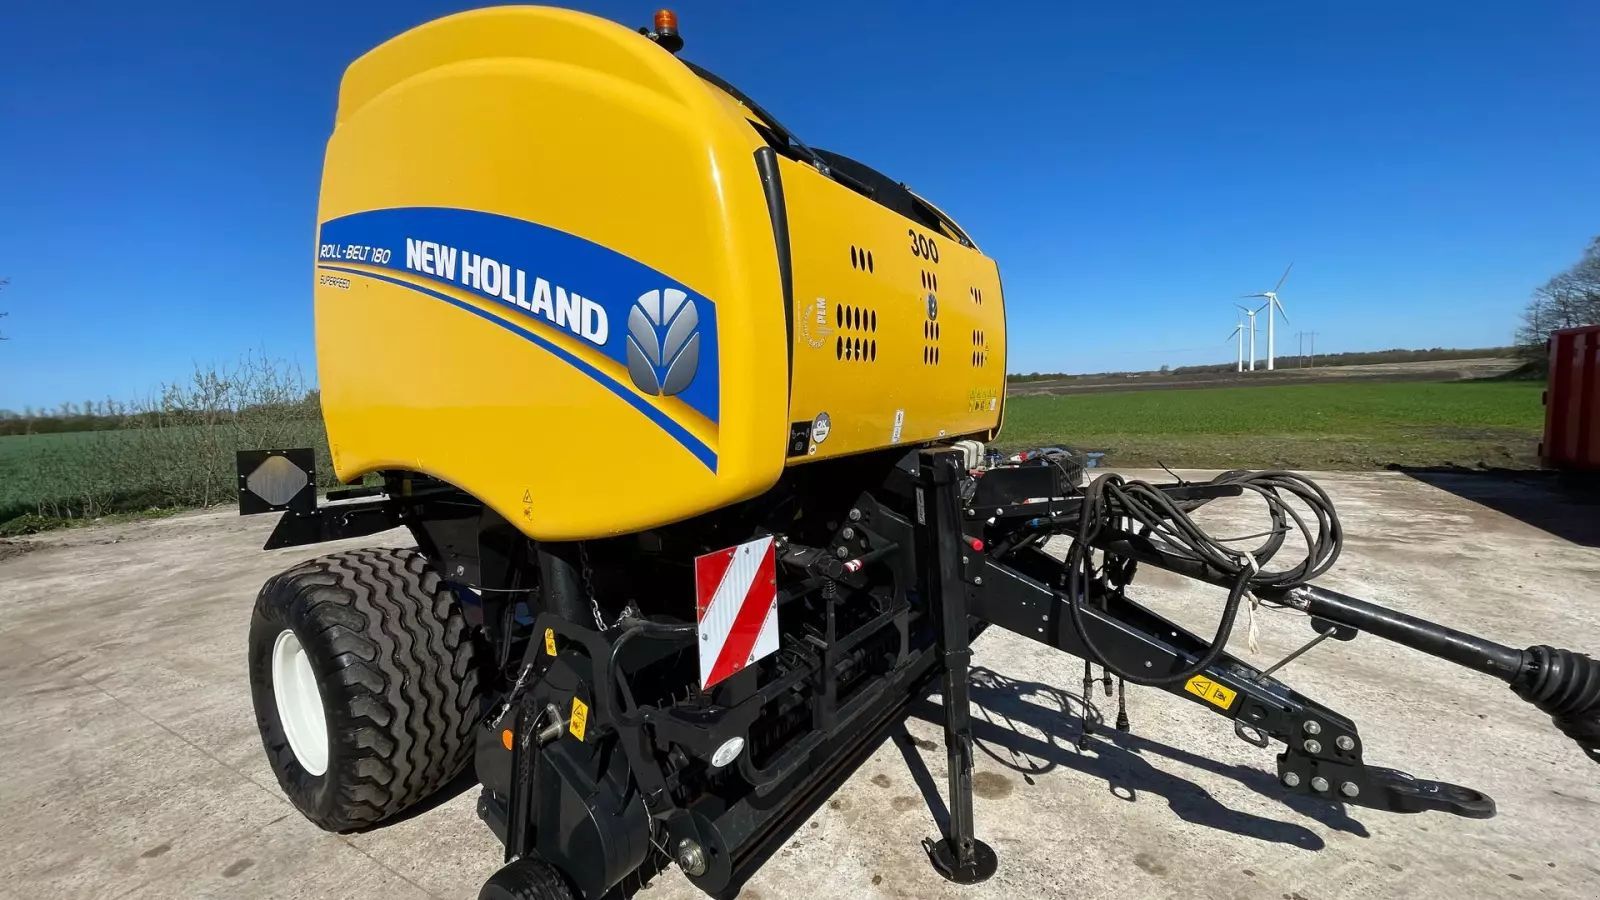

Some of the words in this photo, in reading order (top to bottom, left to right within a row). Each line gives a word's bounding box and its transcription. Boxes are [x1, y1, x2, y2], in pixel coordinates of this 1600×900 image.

[371, 247, 391, 264] 180
[909, 230, 938, 263] 300
[406, 238, 456, 281] NEW
[462, 251, 609, 345] HOLLAND
